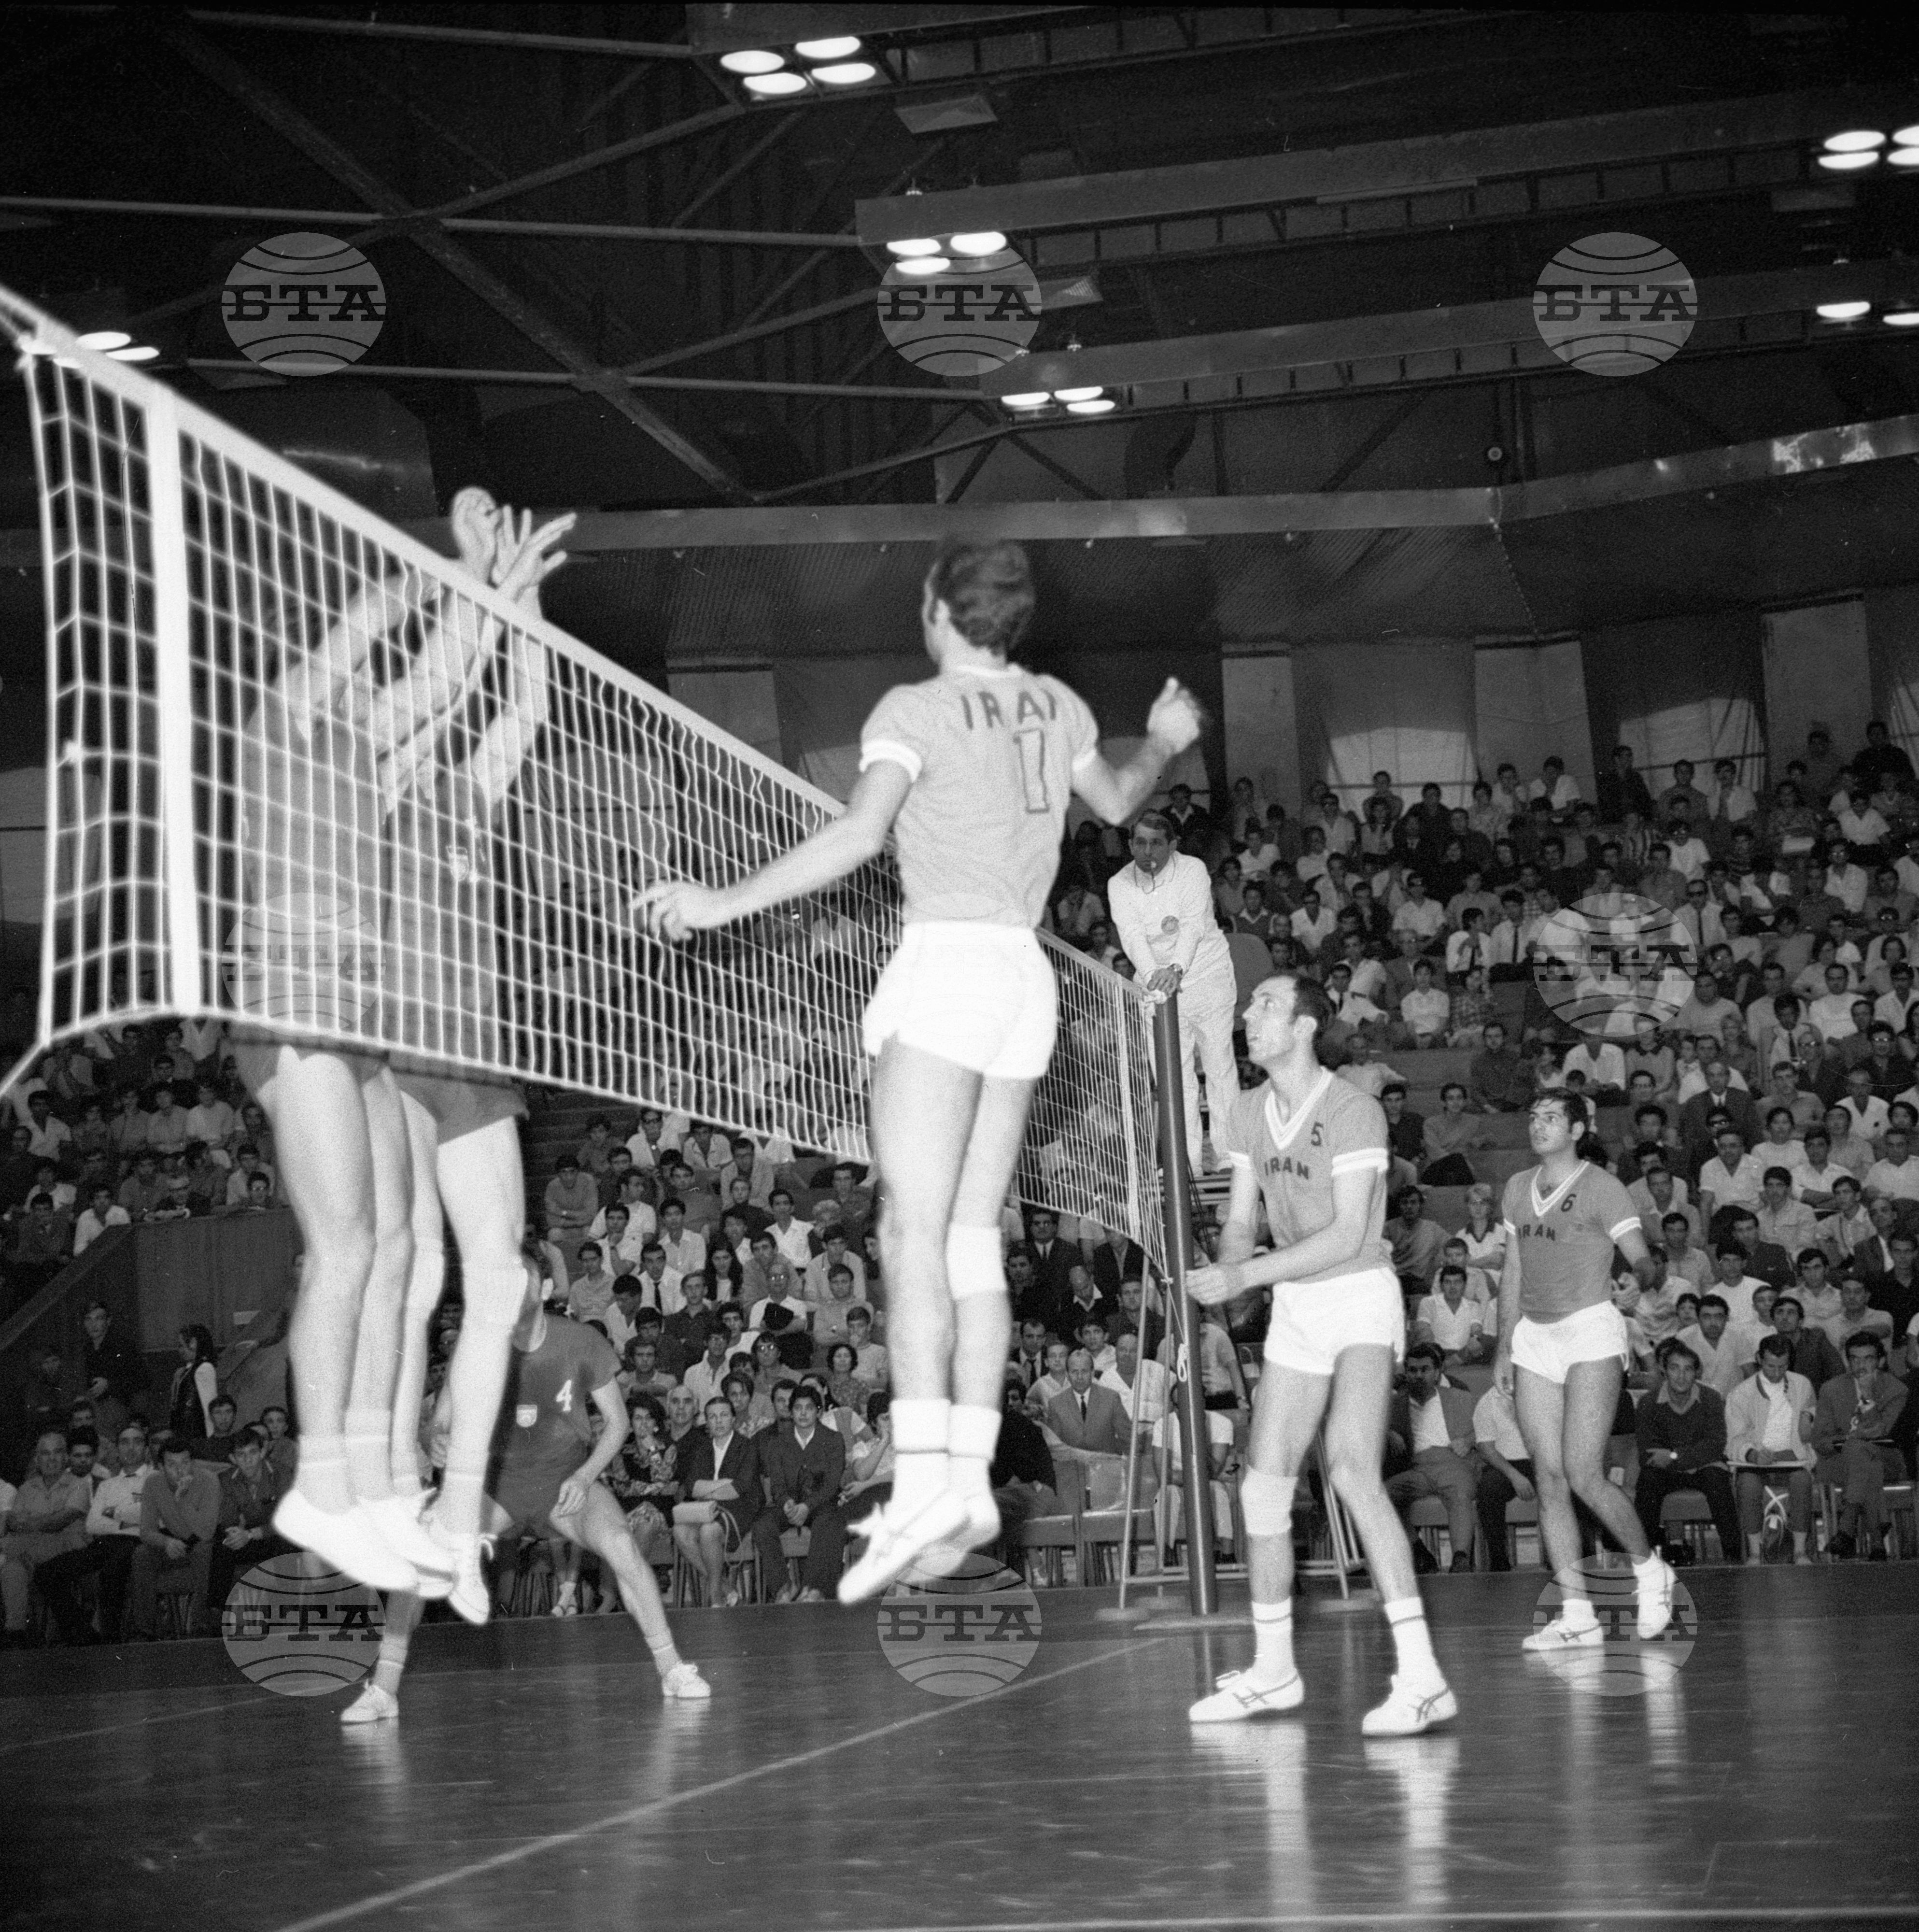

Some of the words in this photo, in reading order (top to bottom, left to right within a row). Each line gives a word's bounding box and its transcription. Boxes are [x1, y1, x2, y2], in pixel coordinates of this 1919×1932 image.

[1013, 728, 1049, 813] 1
[1311, 1121, 1324, 1147] 5
[1264, 1157, 1309, 1180] IRAN
[1561, 1193, 1577, 1212] 6
[556, 1379, 572, 1411] 4
